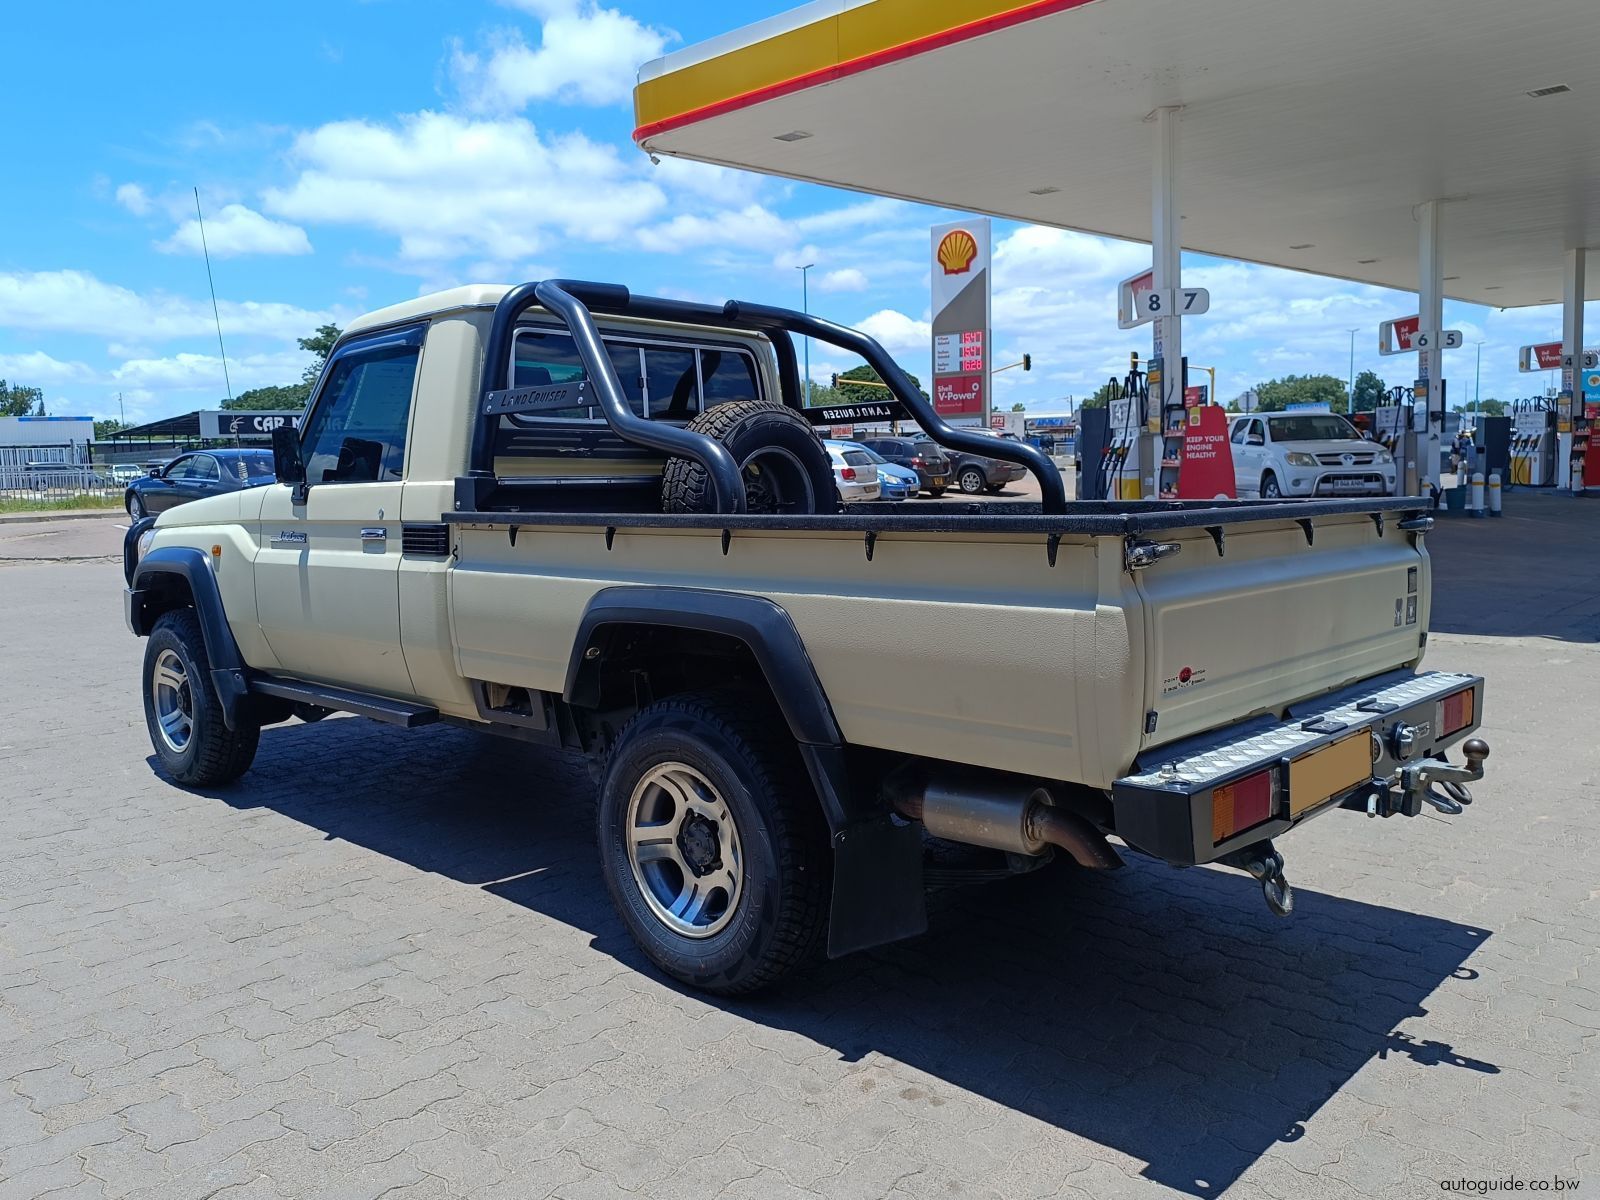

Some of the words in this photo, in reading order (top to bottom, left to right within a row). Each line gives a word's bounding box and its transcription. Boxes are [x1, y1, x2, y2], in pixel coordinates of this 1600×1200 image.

[1149, 294, 1160, 311] 8
[1184, 293, 1197, 309] 7
[1418, 334, 1428, 346] 6
[1446, 334, 1455, 345] 5
[1564, 357, 1573, 366] 4
[1584, 356, 1592, 366] 3
[253, 416, 284, 432] CAR
[1186, 443, 1212, 451] ENGINE
[1186, 451, 1216, 459] HEALTHY
